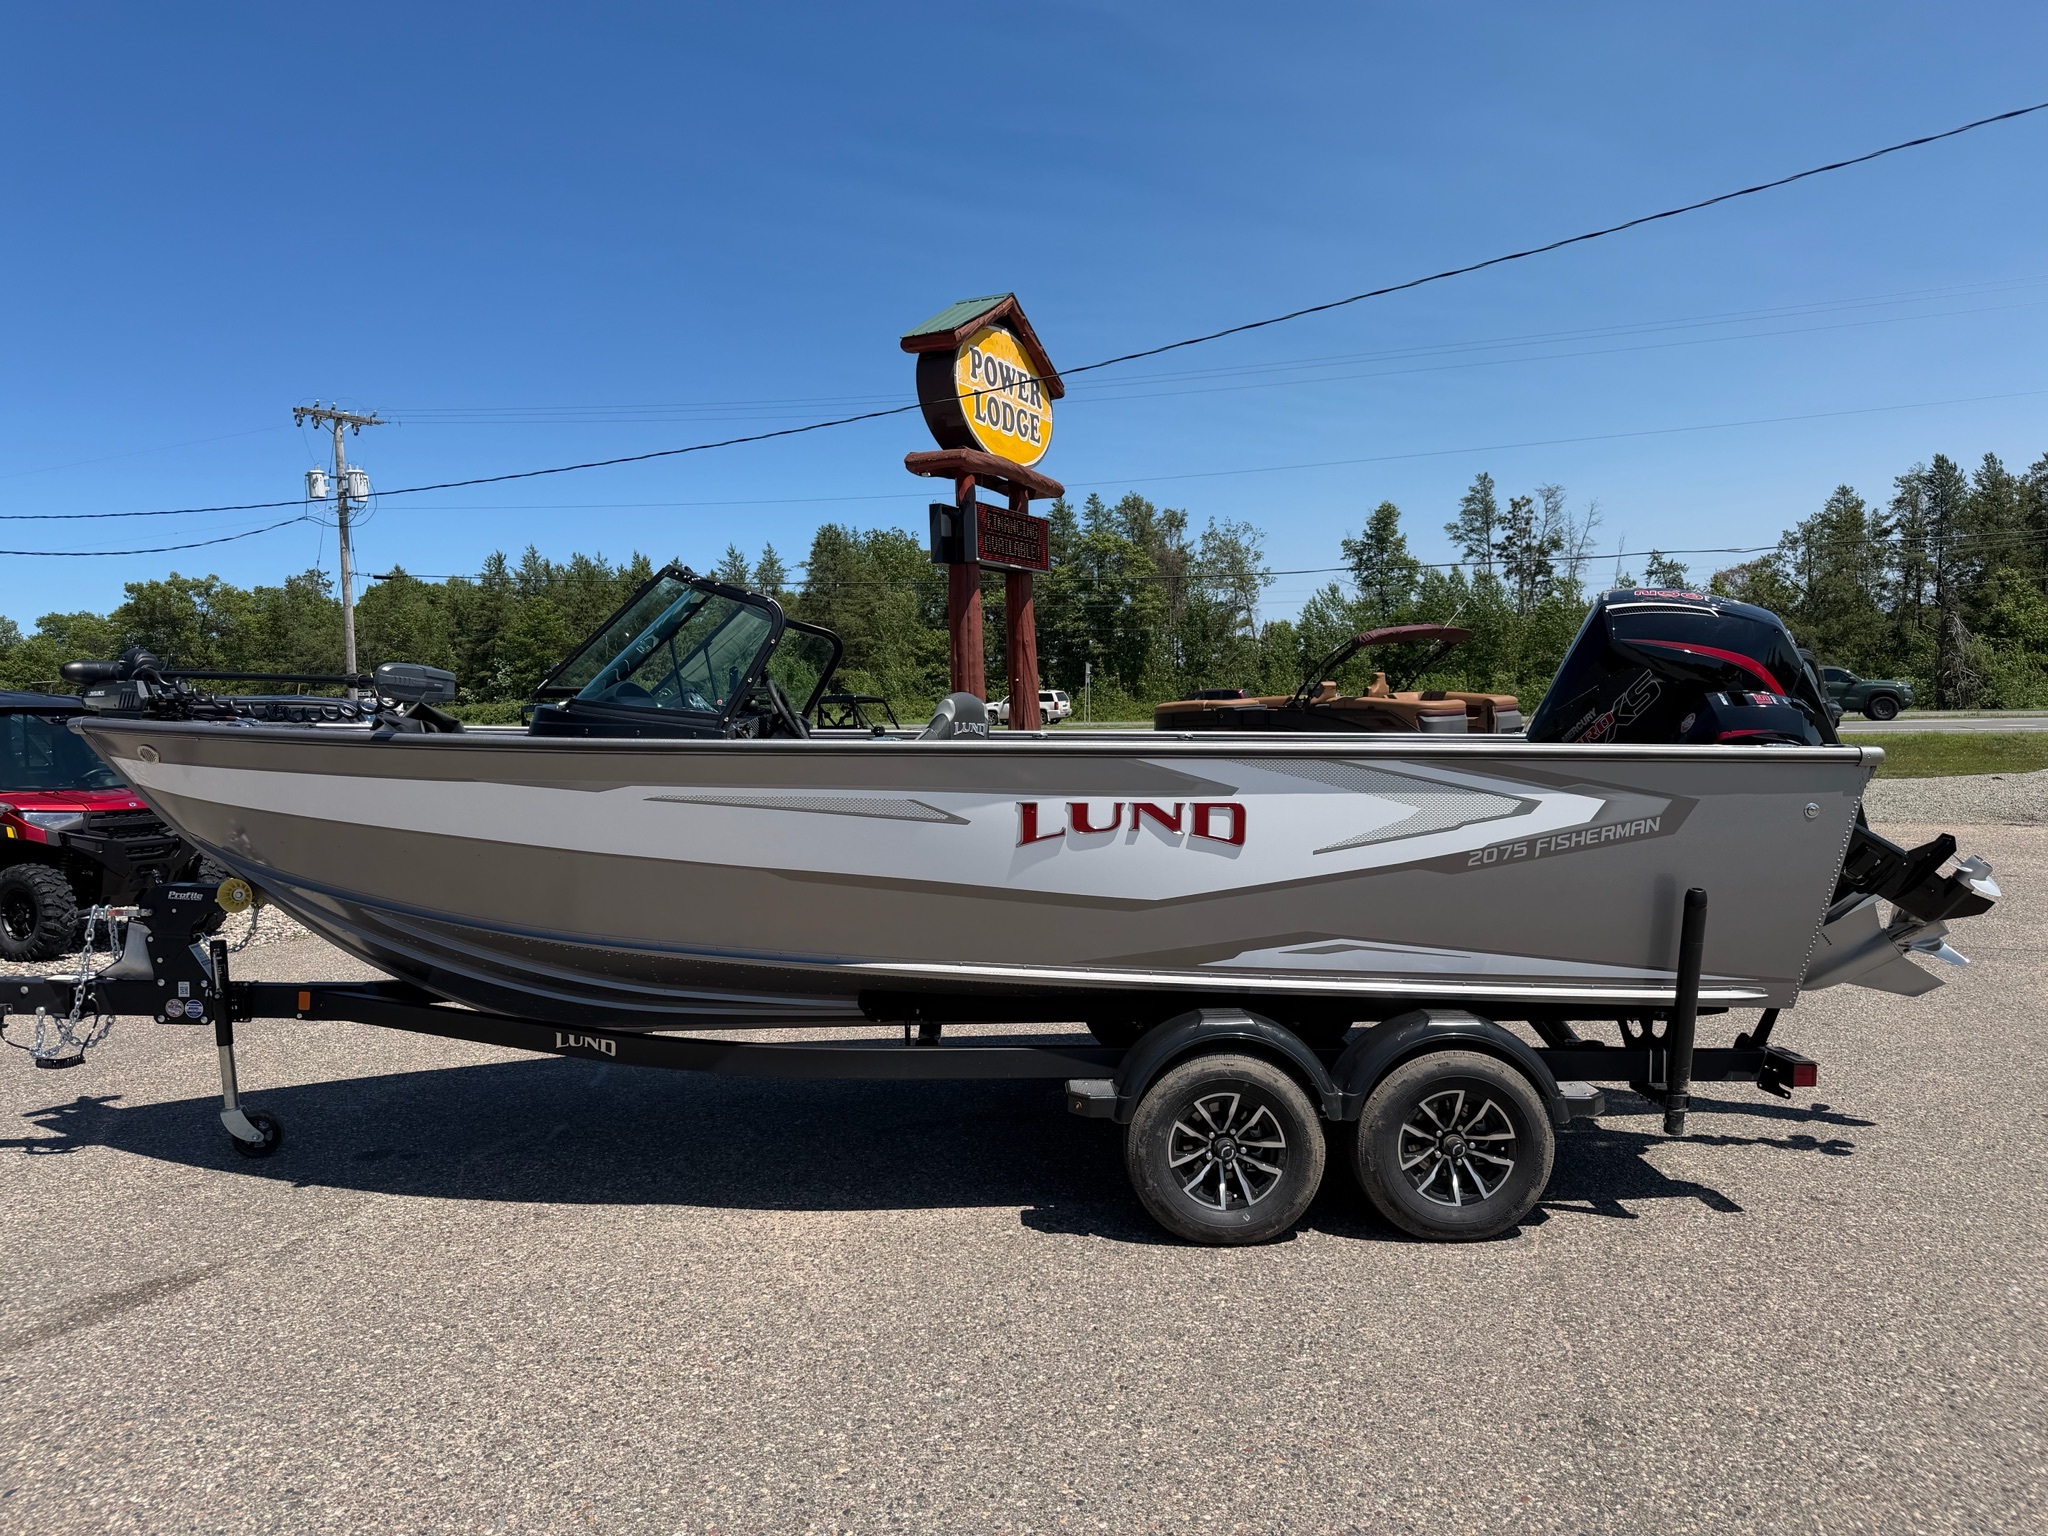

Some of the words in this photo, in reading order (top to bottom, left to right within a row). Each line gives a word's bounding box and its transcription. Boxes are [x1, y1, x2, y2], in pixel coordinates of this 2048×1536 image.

[969, 347, 1042, 409] POWER
[974, 390, 1040, 443] LODGE
[987, 512, 1038, 540] FINANCING
[953, 721, 987, 737] LUND
[1561, 707, 1597, 743] MERCURY
[1015, 801, 1246, 848] LUND
[1467, 841, 1528, 867] 2075
[1534, 816, 1661, 858] FISHERMAN
[168, 890, 204, 900] Profile
[555, 1031, 617, 1057] LUND
